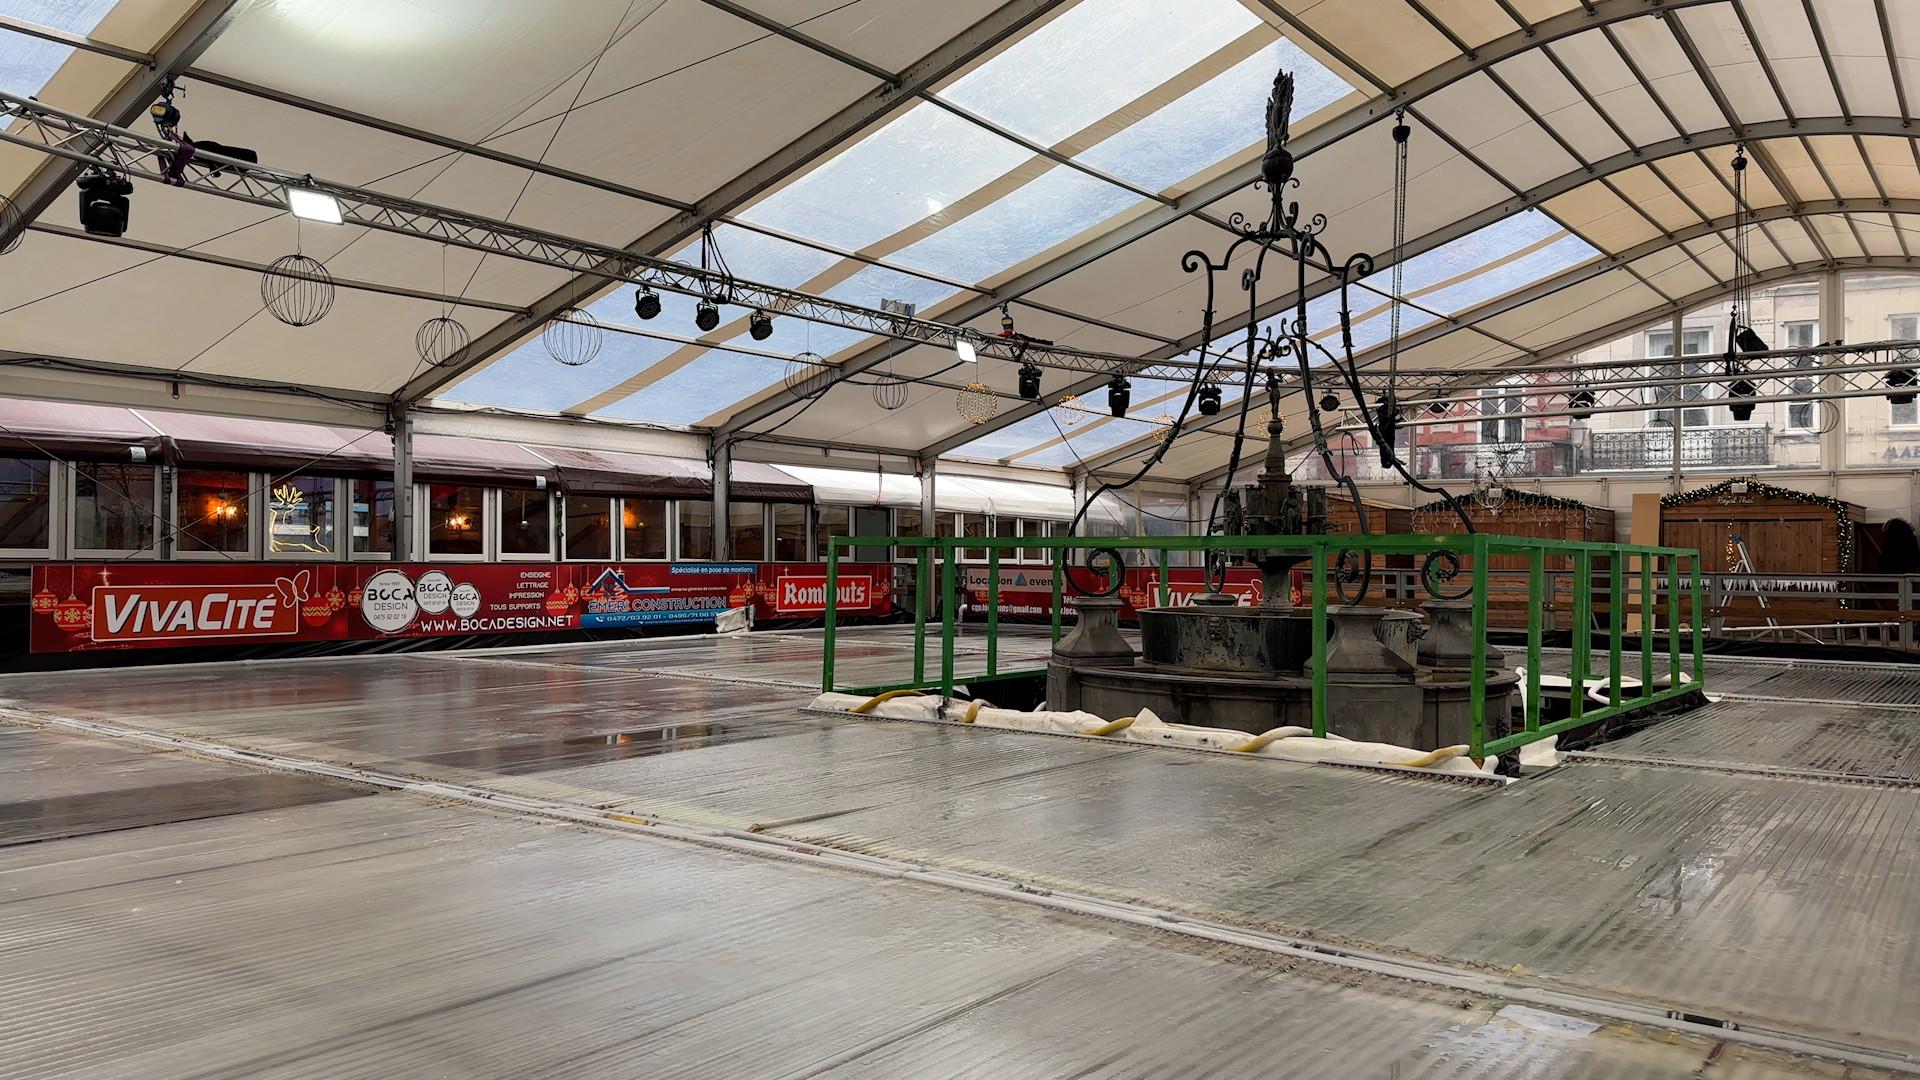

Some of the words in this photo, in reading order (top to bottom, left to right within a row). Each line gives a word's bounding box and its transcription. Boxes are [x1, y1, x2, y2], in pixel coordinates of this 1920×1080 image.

[520, 571, 552, 579] ENSEIGNE
[516, 581, 549, 589] LETTRAGE
[374, 602, 408, 611] DESIGN
[490, 603, 507, 611] TOUS
[508, 602, 541, 610] SUPPORTS
[632, 596, 727, 612] CONSTRUCTION
[421, 614, 574, 632] WWW.BOCADESIGN.NET
